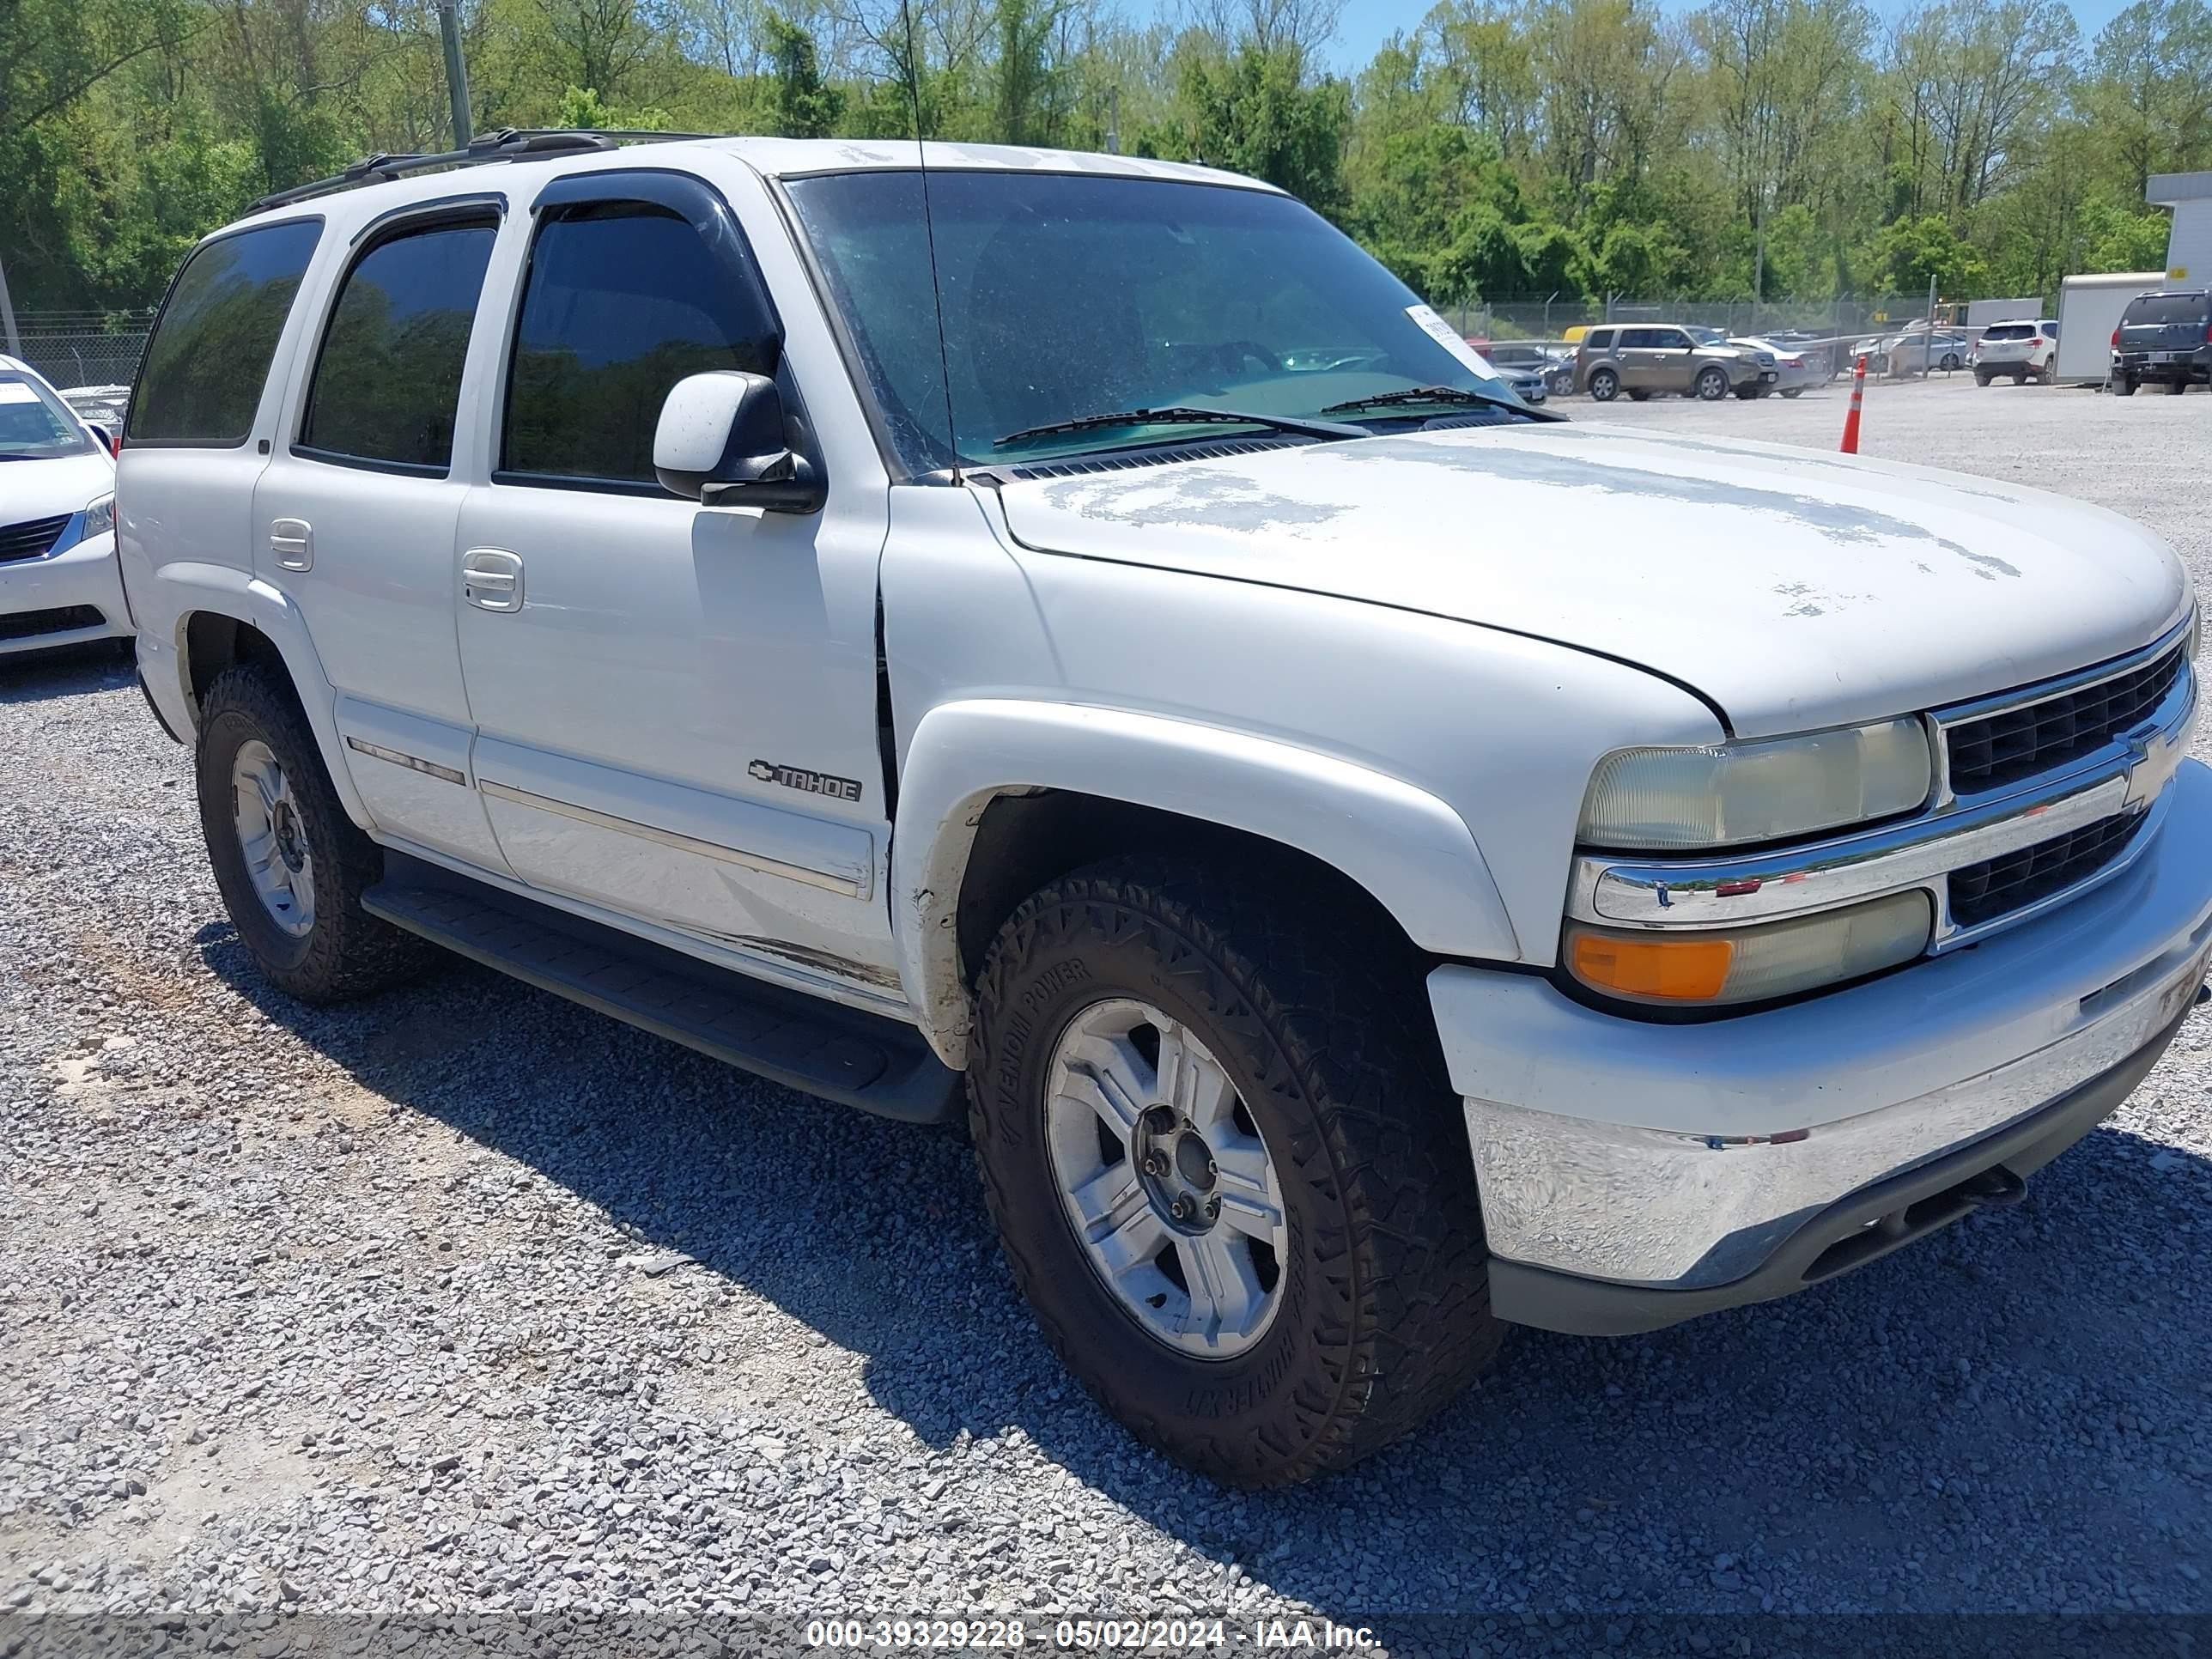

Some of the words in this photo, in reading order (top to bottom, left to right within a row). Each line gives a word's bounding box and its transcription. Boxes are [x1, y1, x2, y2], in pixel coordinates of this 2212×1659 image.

[779, 766, 860, 801] TAHOE
[998, 1011, 1031, 1110] VENOM
[1023, 957, 1093, 1016] POWER
